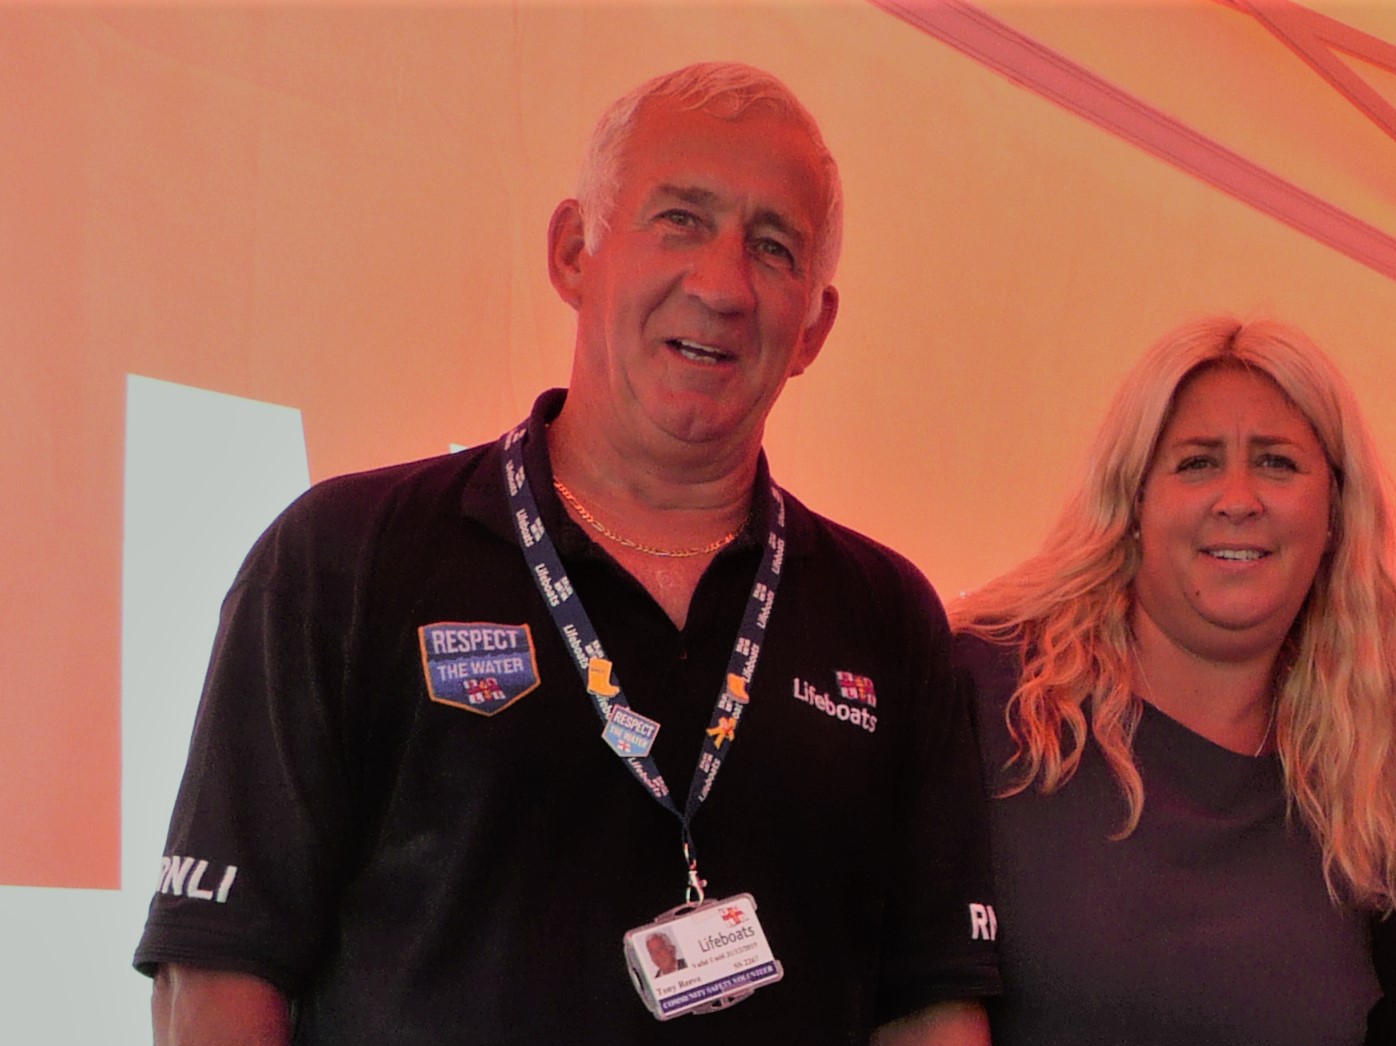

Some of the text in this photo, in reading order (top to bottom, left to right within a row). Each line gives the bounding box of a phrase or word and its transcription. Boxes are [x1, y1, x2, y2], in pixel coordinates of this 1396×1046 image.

[515, 508, 535, 548] Lifeboats
[534, 563, 560, 607] Lifeboats
[757, 589, 776, 629] Lifeboats
[432, 628, 518, 655] RESPECT
[562, 623, 590, 671] Lifeboats
[436, 657, 524, 680] THE WATER
[612, 711, 656, 738] RESPECT
[793, 677, 878, 734] Lifeboats
[629, 757, 663, 799] Lifeboats
[697, 924, 756, 953] Lifeboats
[662, 990, 706, 1010] COMMUNITY
[705, 981, 732, 998] SAFETY
[732, 965, 775, 988] VOLUNTEER
